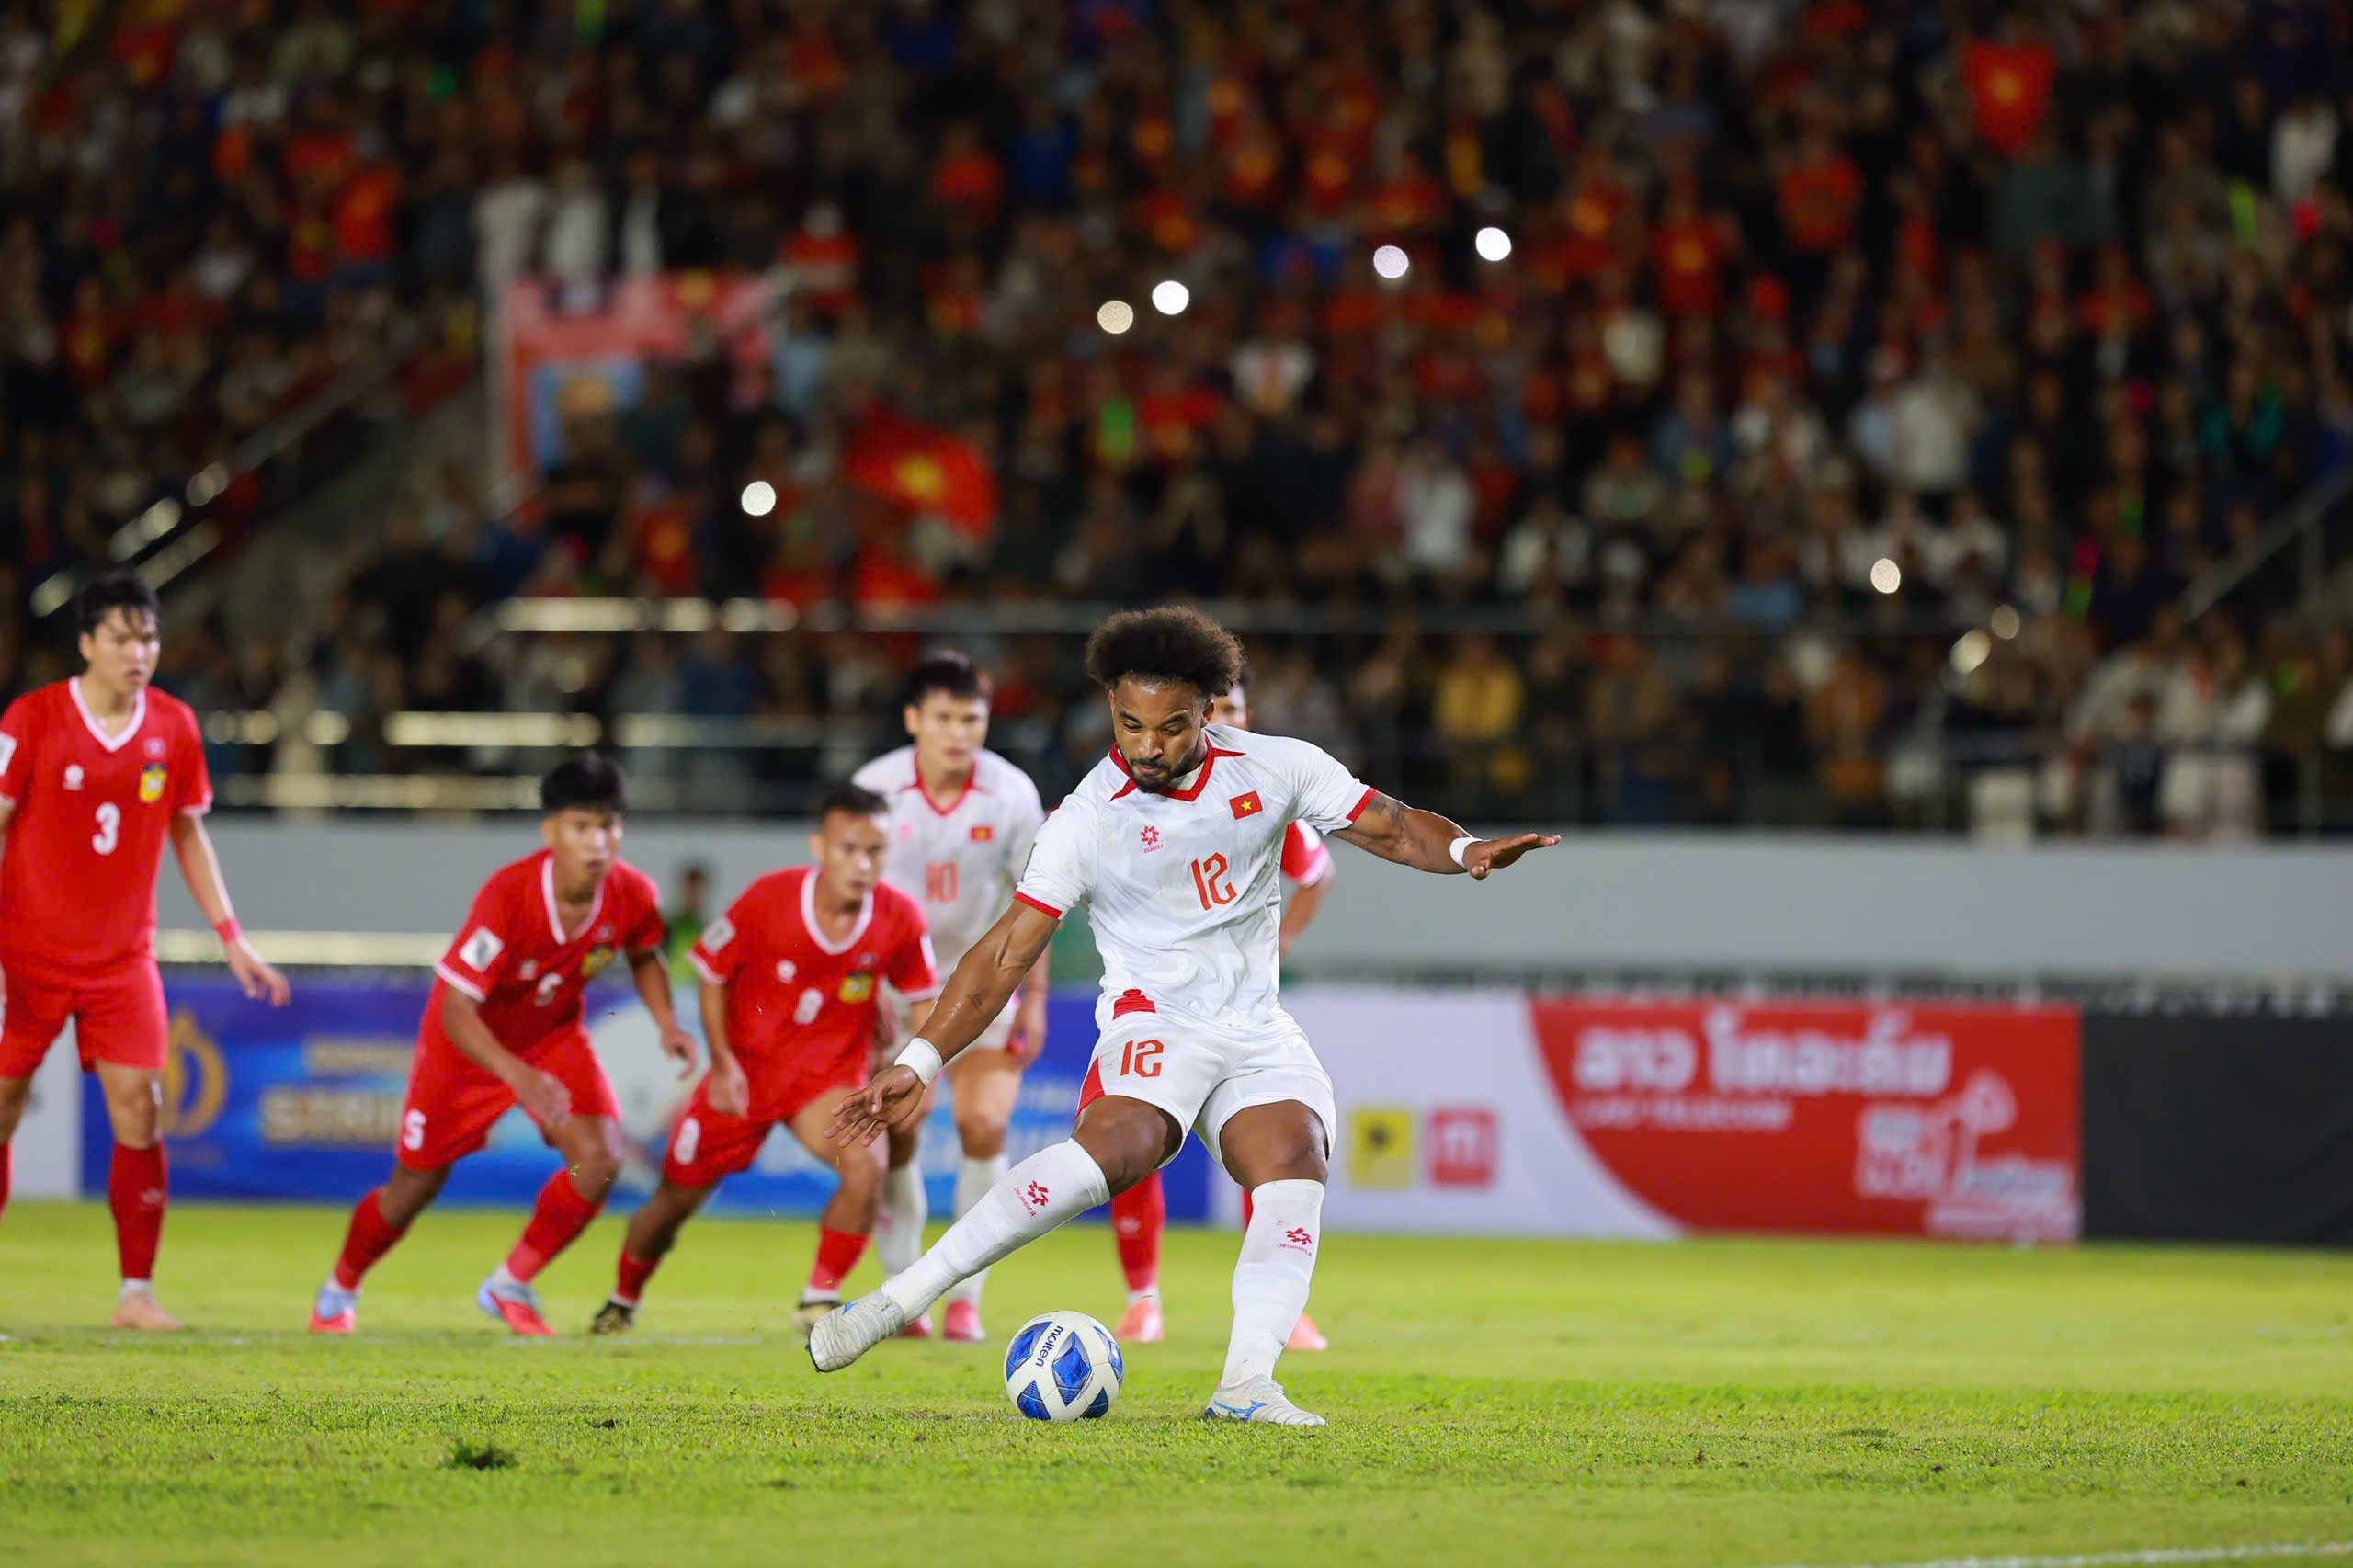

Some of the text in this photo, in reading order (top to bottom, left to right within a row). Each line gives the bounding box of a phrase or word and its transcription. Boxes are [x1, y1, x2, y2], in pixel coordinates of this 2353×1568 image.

[93, 802, 119, 855] 3
[926, 861, 959, 903] 10
[1191, 852, 1237, 911] 12
[1120, 1039, 1164, 1078] 12
[404, 1109, 426, 1151] 5
[674, 1119, 700, 1165] 8
[1035, 1325, 1064, 1368] molten
